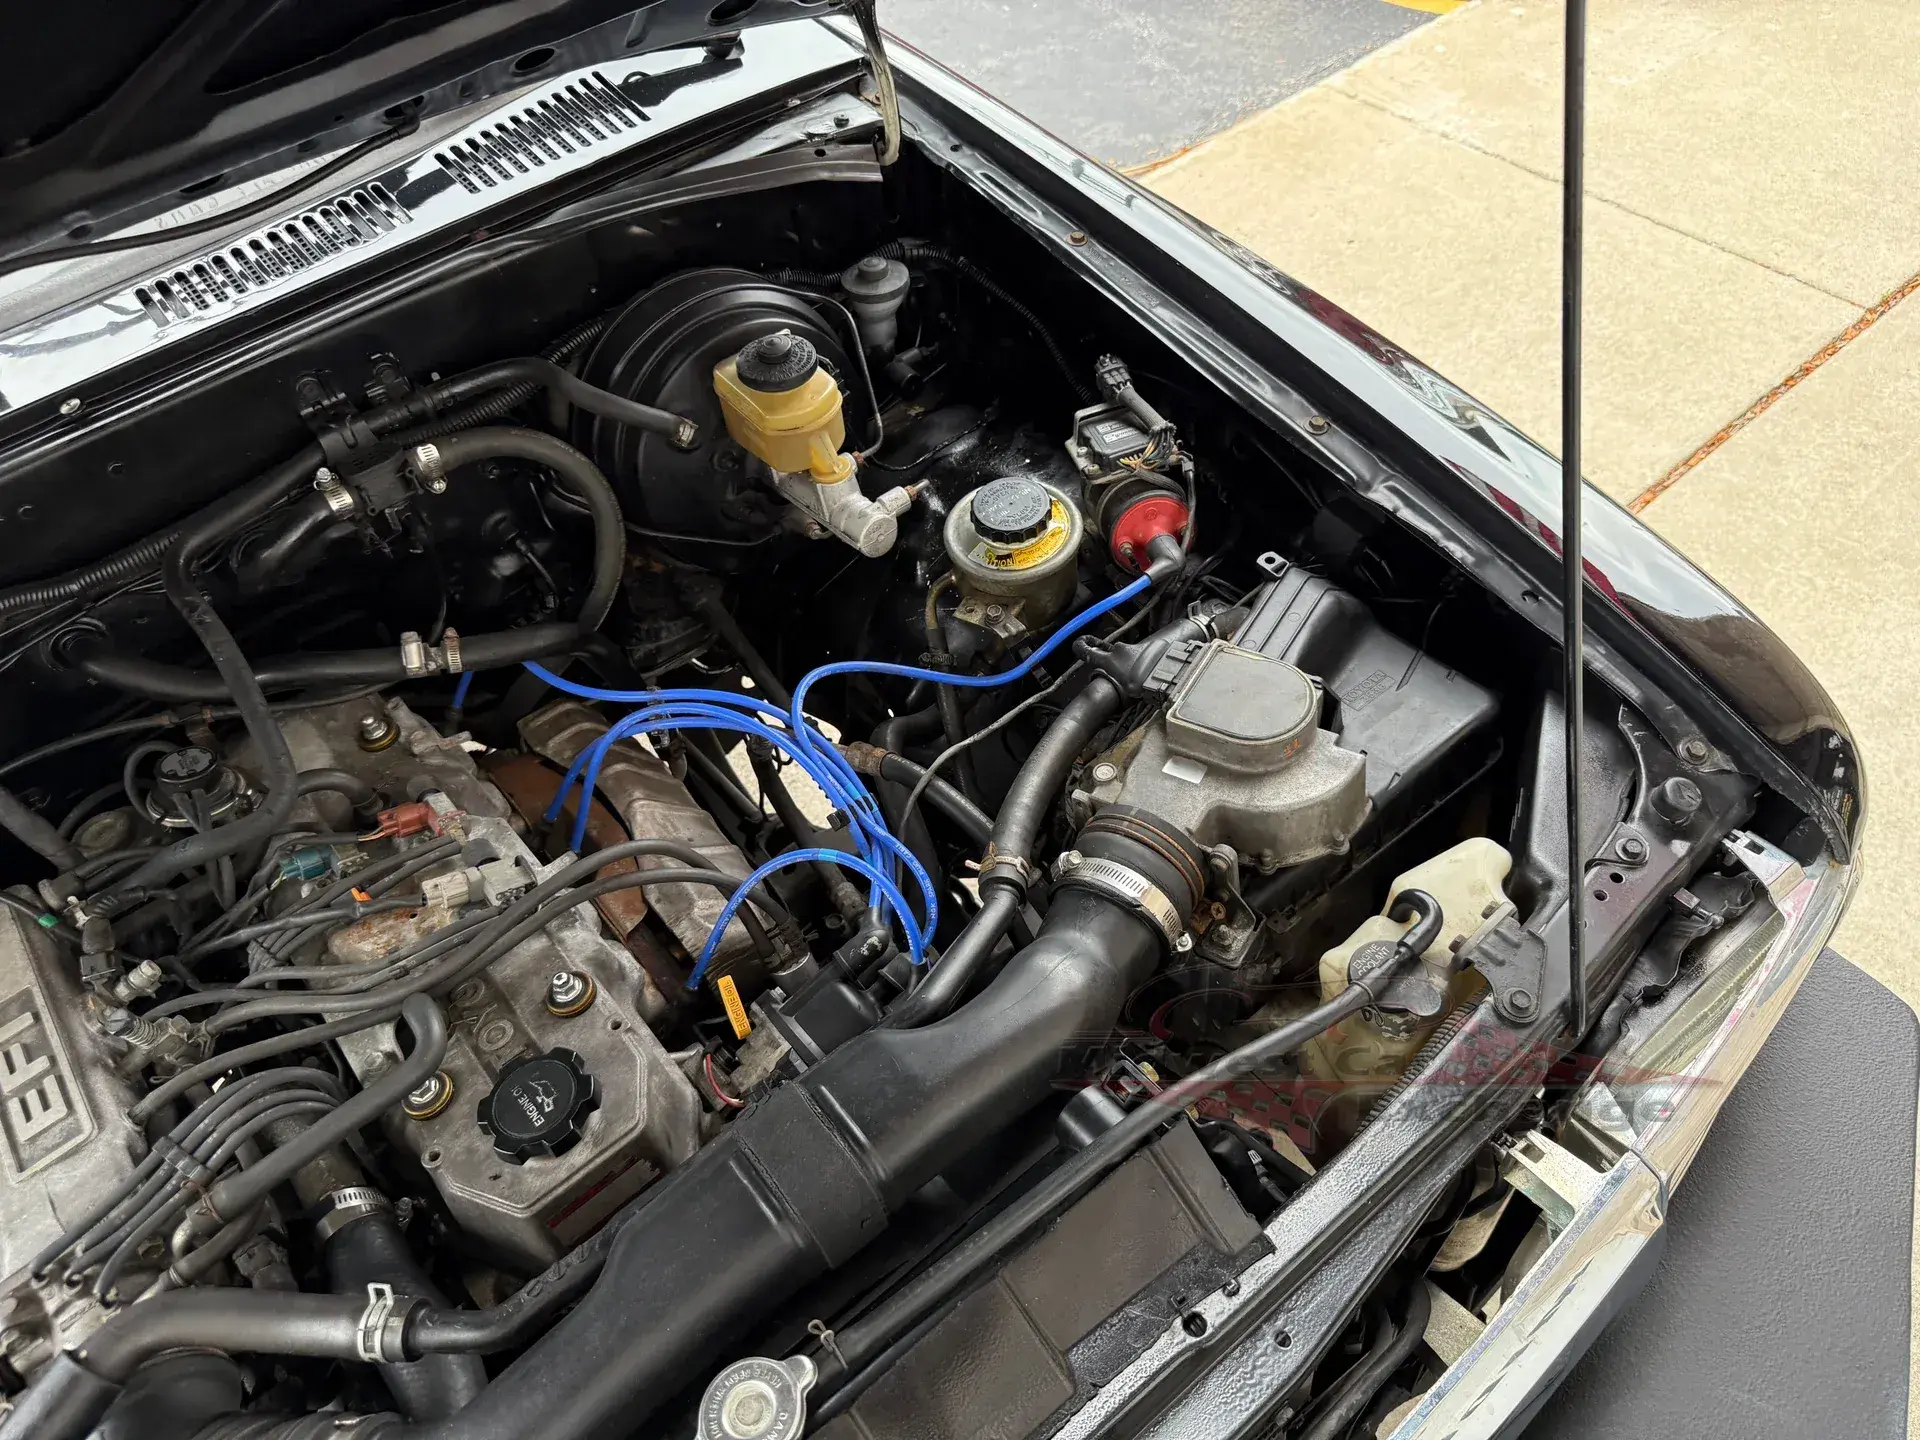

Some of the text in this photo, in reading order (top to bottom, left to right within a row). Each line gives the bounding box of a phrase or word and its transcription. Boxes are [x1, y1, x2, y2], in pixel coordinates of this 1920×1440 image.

[1343, 672, 1387, 703] TOYOTA
[929, 902, 937, 919] NGK
[1352, 943, 1380, 970] ENGINE
[724, 980, 748, 1032] ENGINE OIL
[0, 1011, 69, 1142] EFI
[517, 1095, 545, 1128] ENGINE
